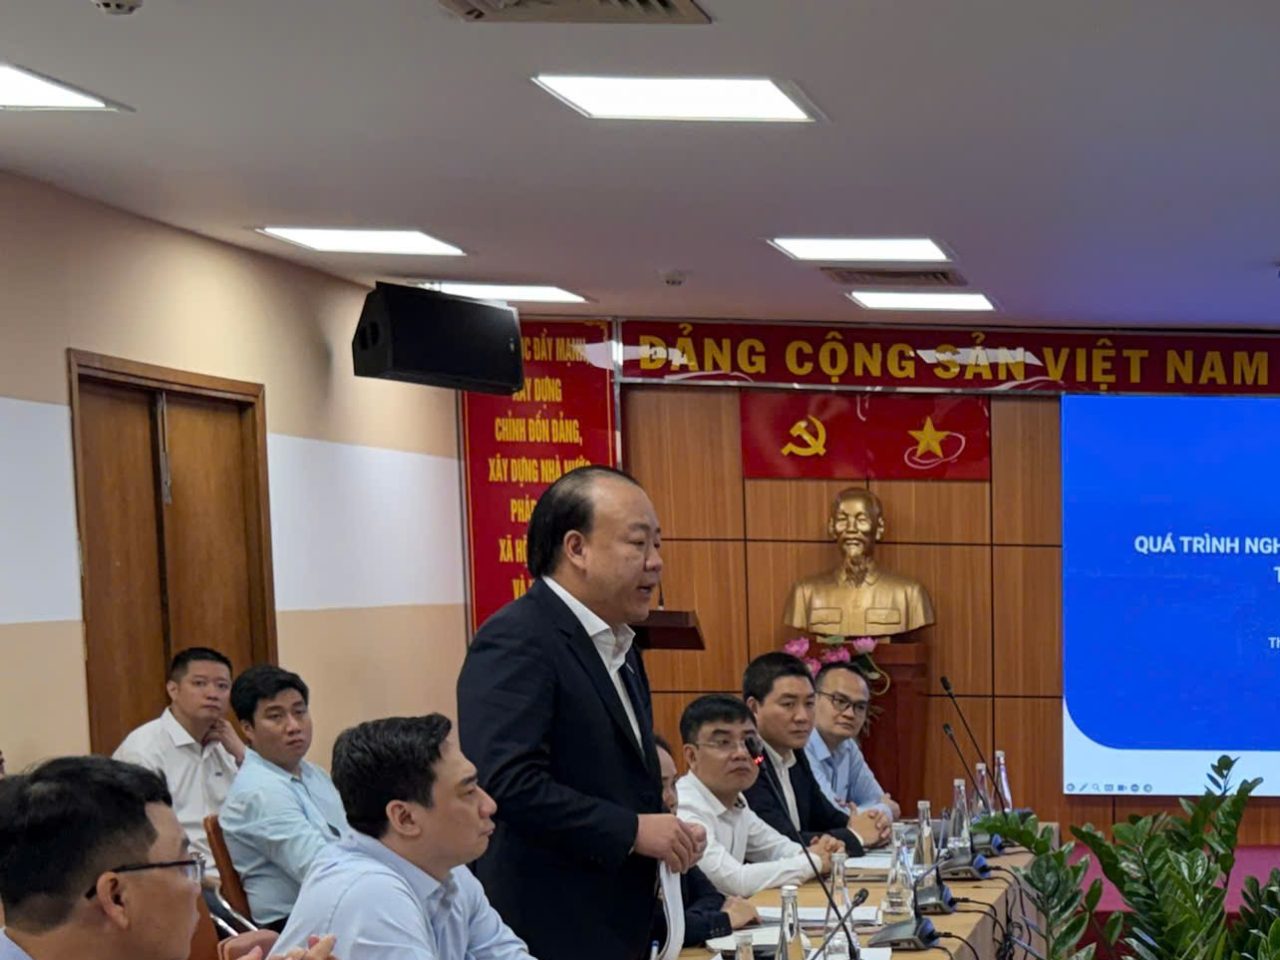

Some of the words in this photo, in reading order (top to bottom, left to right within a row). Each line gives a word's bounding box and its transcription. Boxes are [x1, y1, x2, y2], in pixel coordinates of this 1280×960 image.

[639, 323, 766, 374] ĐẢNG
[785, 331, 915, 383] CỘNG
[932, 332, 1025, 381] SẢN
[1042, 338, 1148, 390] VIỆT
[1167, 349, 1268, 386] NAM
[534, 376, 562, 409] DỰNG
[495, 410, 526, 442] CHỈNH
[488, 453, 509, 482] XÂY
[511, 456, 538, 487] DỰNG
[1134, 532, 1176, 554] QUÁ
[1180, 533, 1240, 554] TRÌNH
